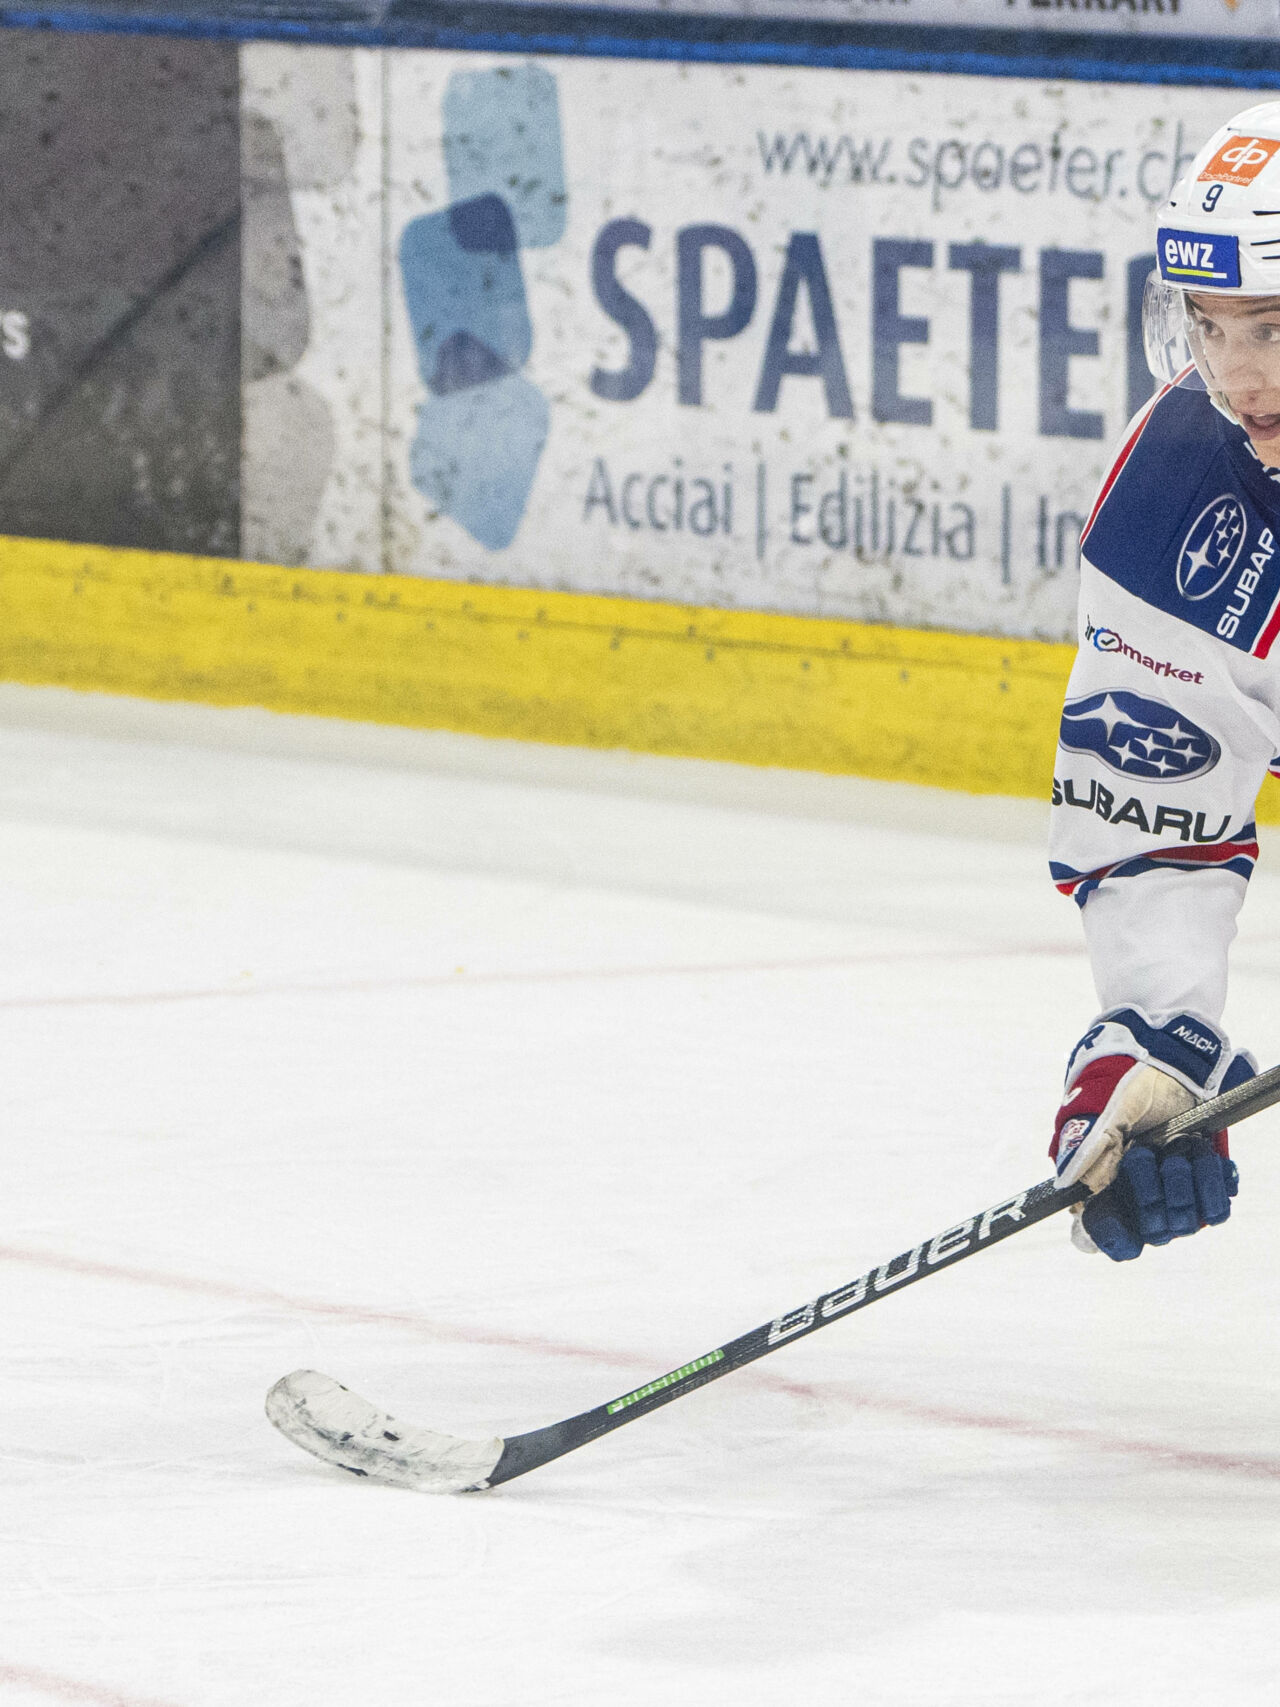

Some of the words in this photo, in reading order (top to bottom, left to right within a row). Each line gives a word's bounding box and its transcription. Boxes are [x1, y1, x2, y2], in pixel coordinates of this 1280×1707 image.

[1202, 184, 1224, 212] 9
[1164, 238, 1215, 269] ewz
[584, 454, 734, 538] Acciai
[789, 467, 976, 562] Edilizia
[1051, 772, 1232, 843] SUBARU
[1172, 1025, 1219, 1055] MACH
[768, 1192, 1028, 1345] BAUER
